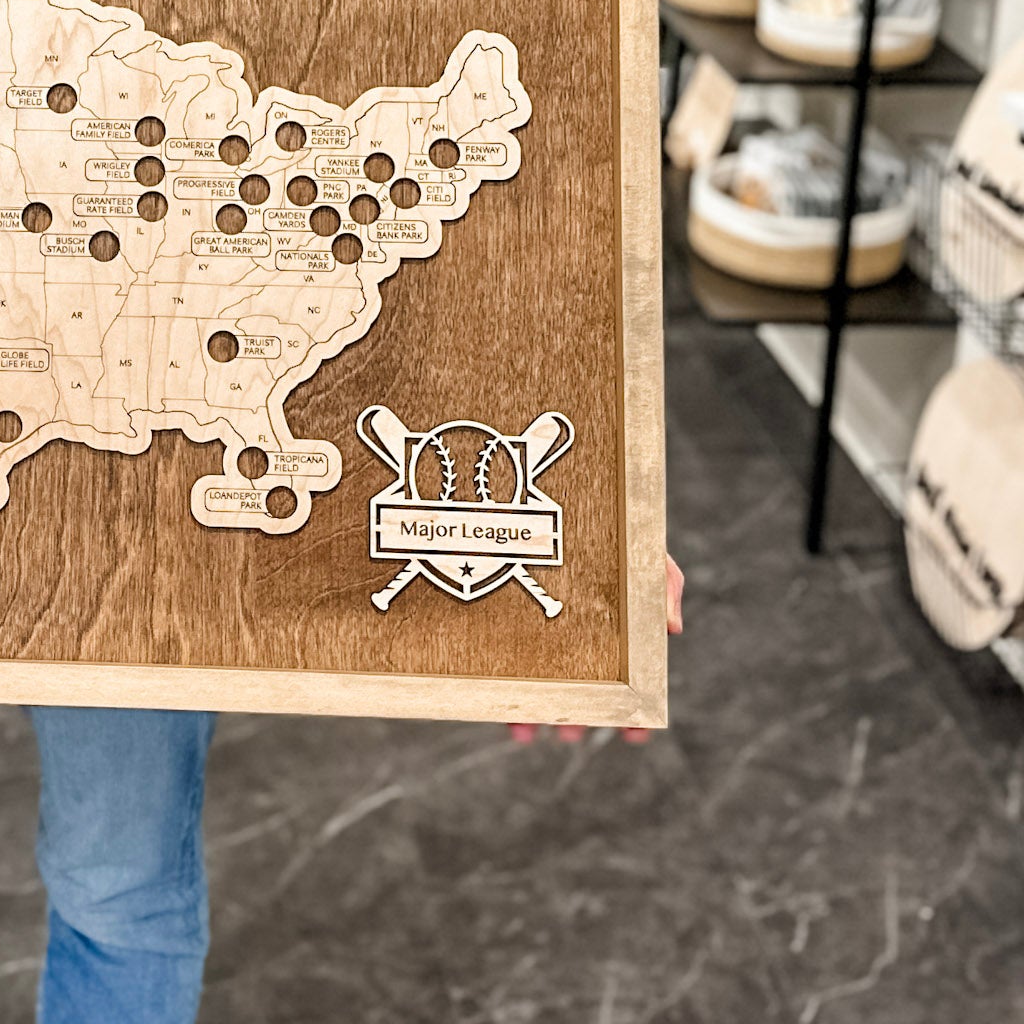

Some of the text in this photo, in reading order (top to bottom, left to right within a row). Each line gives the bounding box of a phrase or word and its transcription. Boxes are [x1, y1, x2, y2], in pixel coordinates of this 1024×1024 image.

[274, 111, 287, 119] ON
[108, 131, 131, 139] FIELD
[311, 129, 346, 137] ROGERS
[169, 141, 215, 149] COMERICA
[311, 137, 346, 145] CENTRE
[466, 146, 500, 154] FENWAY
[93, 162, 130, 170] WRIGLEY
[327, 159, 360, 167] YANKEE
[321, 167, 360, 175] STADIUM
[178, 180, 235, 188] PROGRESSIVE
[356, 184, 367, 192] PA
[211, 189, 235, 197] FIELD
[426, 186, 444, 194] CITI
[77, 197, 133, 205] GUARANTEED
[426, 194, 451, 202] FIELD
[247, 207, 261, 215] OH
[137, 227, 144, 235] IL
[377, 223, 416, 231] CITIZENS
[56, 237, 85, 245] BUSCH
[194, 237, 268, 246] GREAT AMERICAN
[47, 246, 85, 254] STADIUM
[280, 253, 329, 261] NATIONALS
[303, 275, 315, 283] VA
[172, 297, 184, 305] TN
[71, 311, 83, 319] AR
[244, 338, 274, 347] TRUIST
[287, 340, 299, 348] SC
[244, 347, 265, 355] PARK
[1, 352, 29, 360] GLOBE
[1, 360, 45, 369] LIFE FIELD
[71, 381, 82, 389] LA
[230, 383, 242, 391] GA
[274, 455, 324, 463] TROPICANA
[274, 464, 299, 472] FIELD
[209, 492, 261, 501] LOANDEPOT
[241, 501, 261, 510] PARK
[400, 521, 532, 544] Major League
